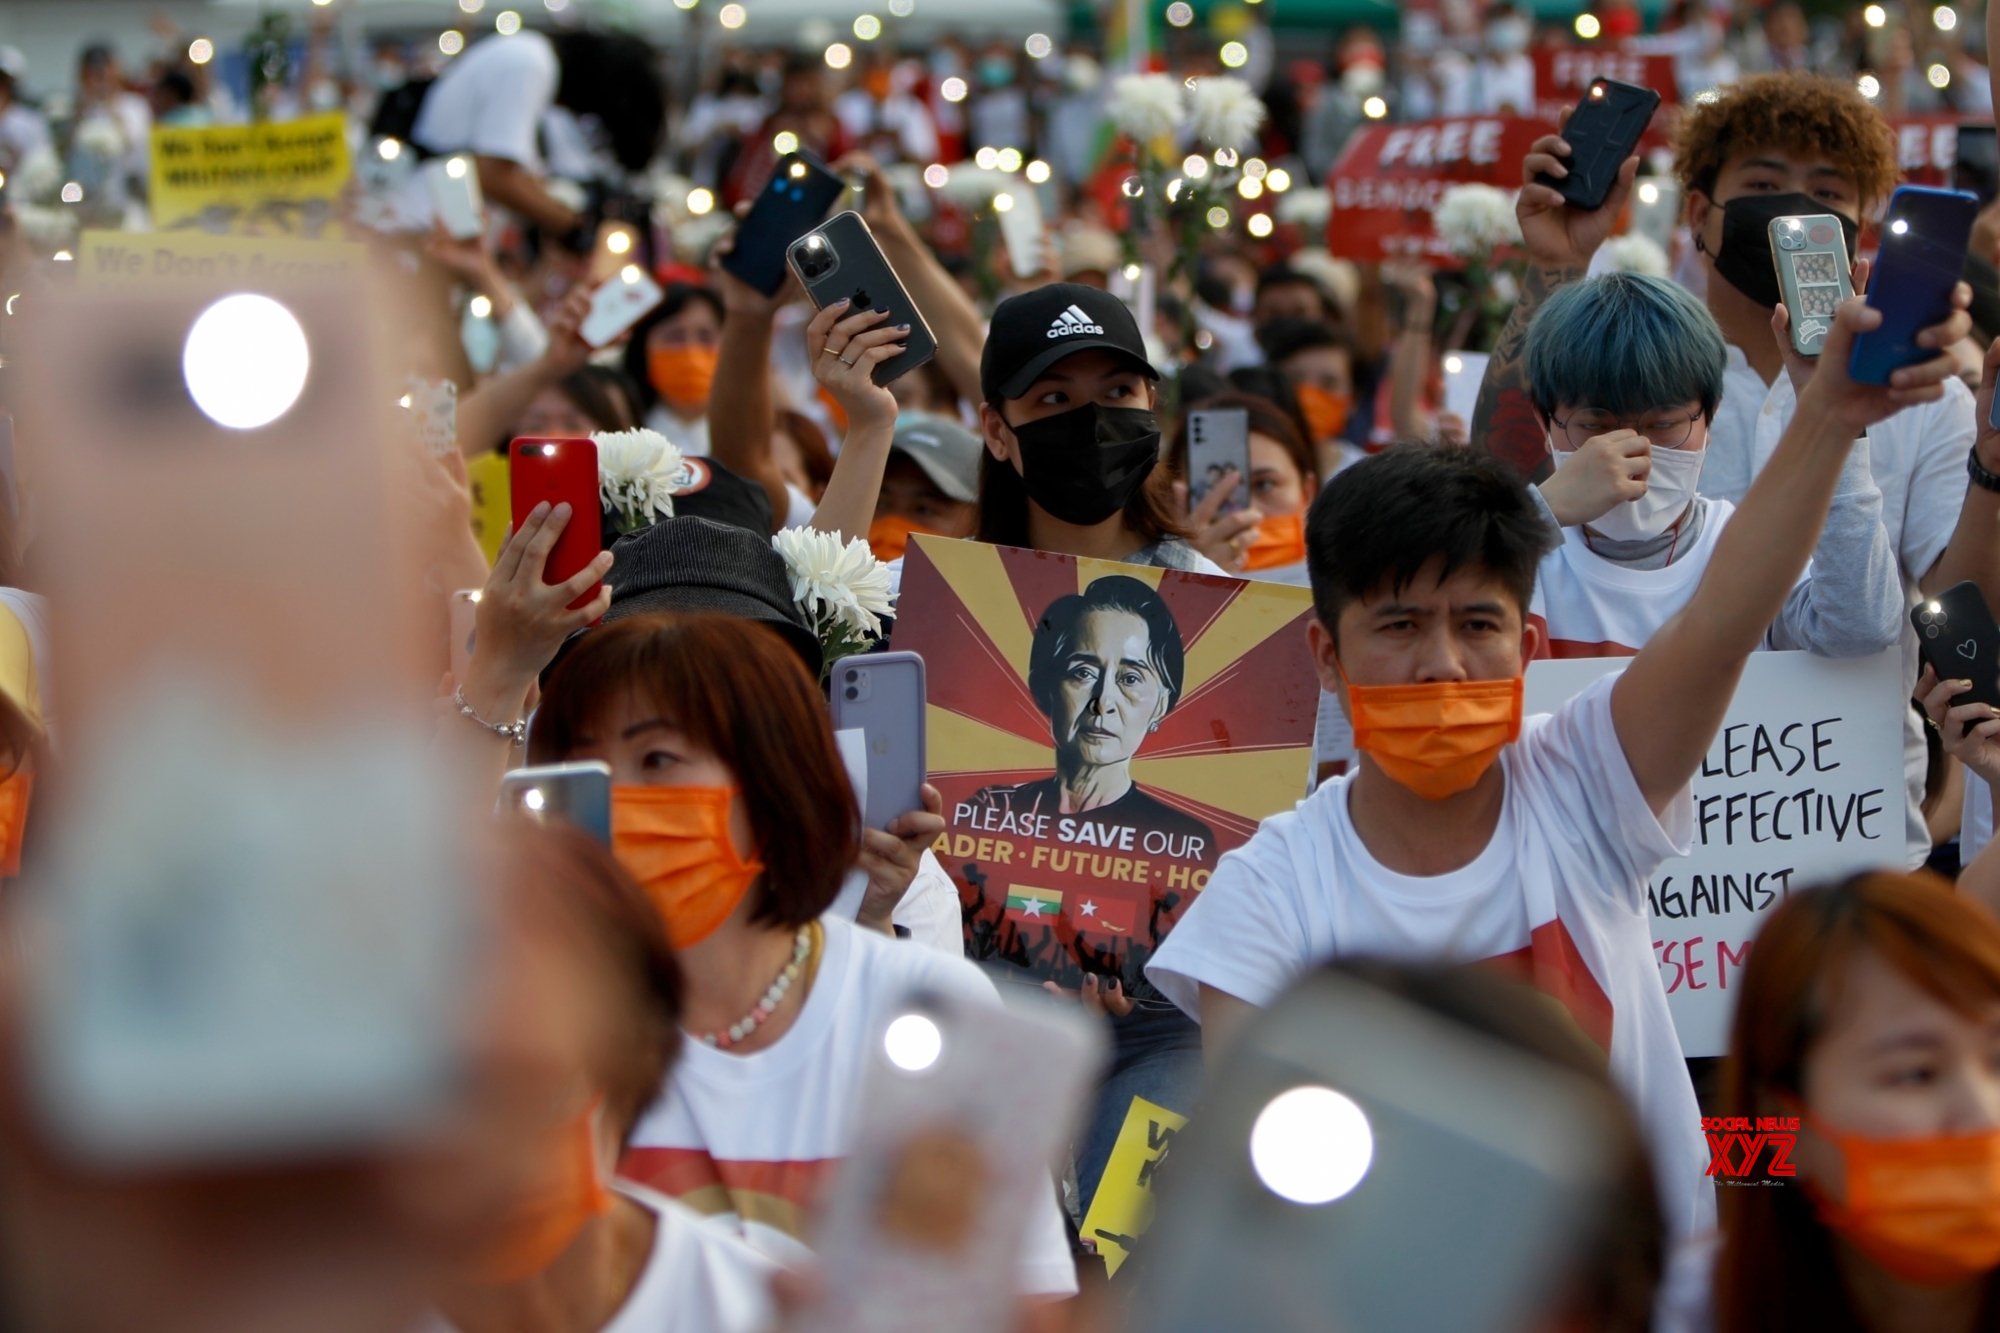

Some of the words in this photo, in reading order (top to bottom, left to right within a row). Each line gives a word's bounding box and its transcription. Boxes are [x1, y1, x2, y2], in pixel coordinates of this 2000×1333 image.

[1378, 118, 1504, 168] FREE
[94, 245, 145, 275] We
[152, 248, 239, 276] Don't
[1046, 323, 1104, 339] adidas
[1702, 717, 1843, 778] LEASE
[953, 803, 1051, 839] PLEASE
[1057, 818, 1137, 851] SAVE
[1143, 830, 1205, 861] OUR
[1693, 788, 1884, 846] FFECTIVE
[931, 831, 1014, 865] ADER
[1031, 845, 1150, 884] FUTURE
[1166, 864, 1212, 892] HO
[1716, 940, 1753, 990] M
